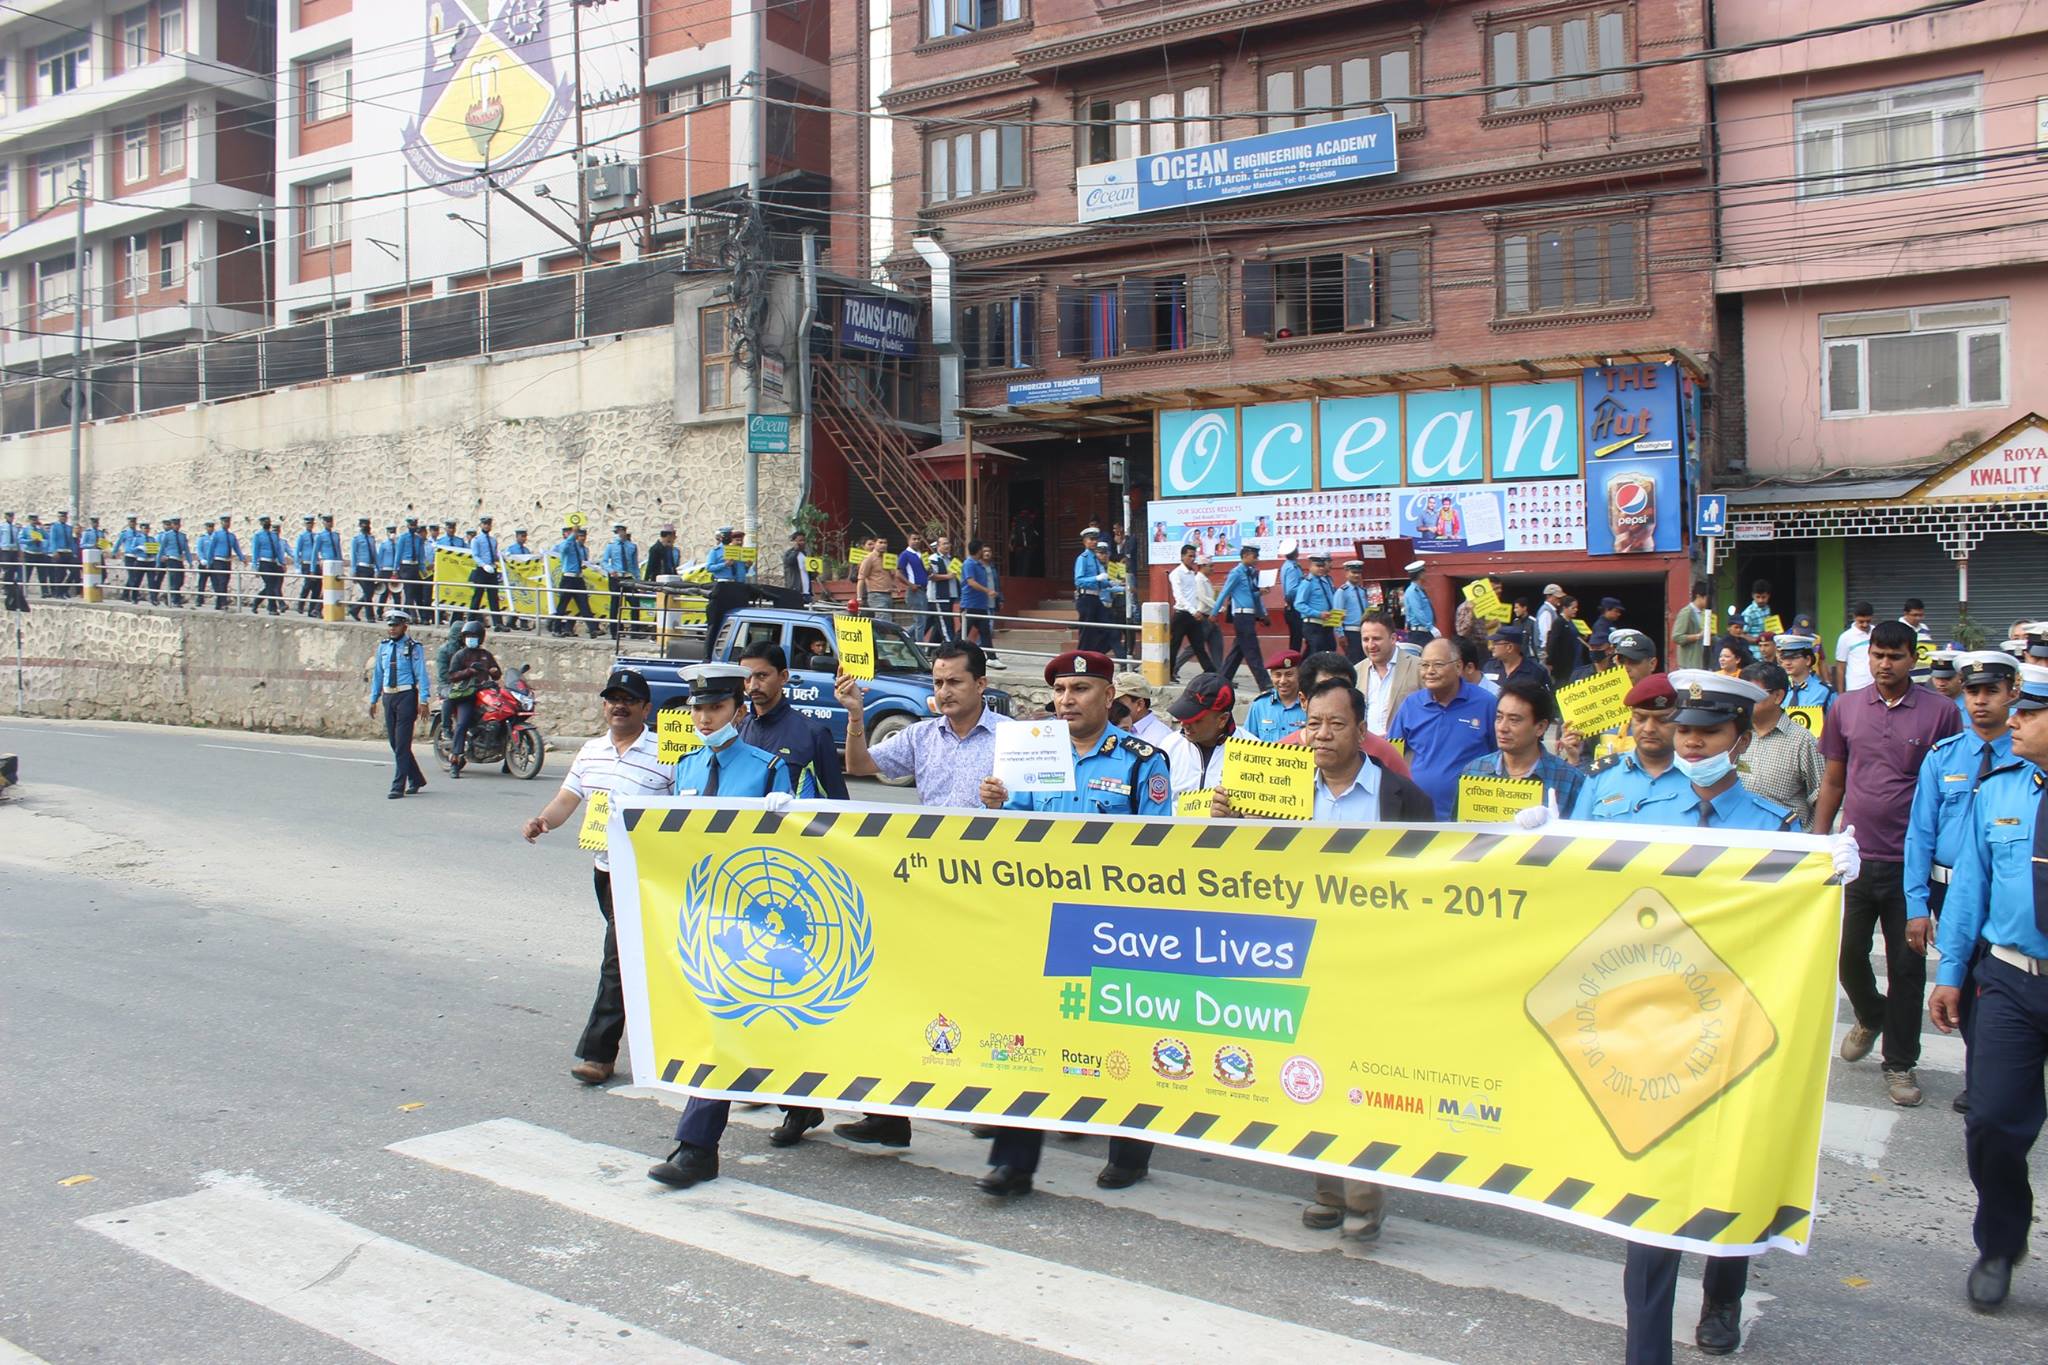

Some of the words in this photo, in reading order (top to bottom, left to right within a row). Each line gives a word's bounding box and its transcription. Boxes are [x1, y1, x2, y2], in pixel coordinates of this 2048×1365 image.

[1150, 148, 1229, 187] OCEAN
[1233, 144, 1312, 170] ENGINEERING
[1315, 134, 1377, 157] ACADEMY
[1253, 165, 1297, 180] Entrance
[1299, 154, 1358, 173] Preparation
[1086, 188, 1135, 207] Ocean
[845, 298, 918, 339] TRANSLATION
[854, 331, 880, 349] Notary
[1009, 382, 1052, 392] AUTHORIZED
[1053, 376, 1100, 388] TRANSLATION
[1602, 365, 1657, 392] THE
[750, 415, 788, 432] Ocean
[1591, 407, 1652, 441] Hut
[1168, 402, 1567, 492] Ocean
[1970, 466, 2041, 486] KWALITY
[1191, 506, 1216, 514] SUCCESS
[1217, 504, 1242, 513] RESULTS
[1617, 515, 1648, 526] pepsi
[793, 686, 819, 701] प्रहरी
[664, 720, 682, 733] गति
[661, 740, 687, 752] जीवन
[1243, 753, 1272, 767] बजाएर
[1184, 799, 1201, 811] गति
[1258, 793, 1277, 803] कम
[938, 858, 983, 885] UN
[992, 860, 1092, 891] Global
[1101, 865, 1186, 896] Road
[1197, 868, 1304, 910] Safety
[1314, 874, 1409, 911] Week
[1443, 884, 1528, 920] 2017
[1092, 921, 1182, 960] Save
[1195, 926, 1295, 970] Lives
[1591, 943, 1648, 980] ACTION
[1651, 943, 1682, 974] FOR
[1578, 973, 1602, 998] OF
[1681, 964, 1721, 1012] ROAD
[1099, 982, 1181, 1022] Slow
[1195, 990, 1294, 1035] Down
[979, 1040, 1008, 1049] SAFETY
[990, 1032, 1014, 1042] ROAD
[1576, 1000, 1606, 1068] DECADE
[1008, 1054, 1034, 1063] NEPAL
[1062, 1049, 1102, 1068] Rotary
[1684, 1017, 1721, 1080] SAFETY
[1349, 1060, 1358, 1072] A
[1361, 1061, 1409, 1079] SOCIAL
[1413, 1069, 1480, 1089] INITIATIVE
[1484, 1078, 1503, 1091] OF
[1602, 1066, 1681, 1101] 2011-2020
[1365, 1090, 1424, 1115] YAMAHA
